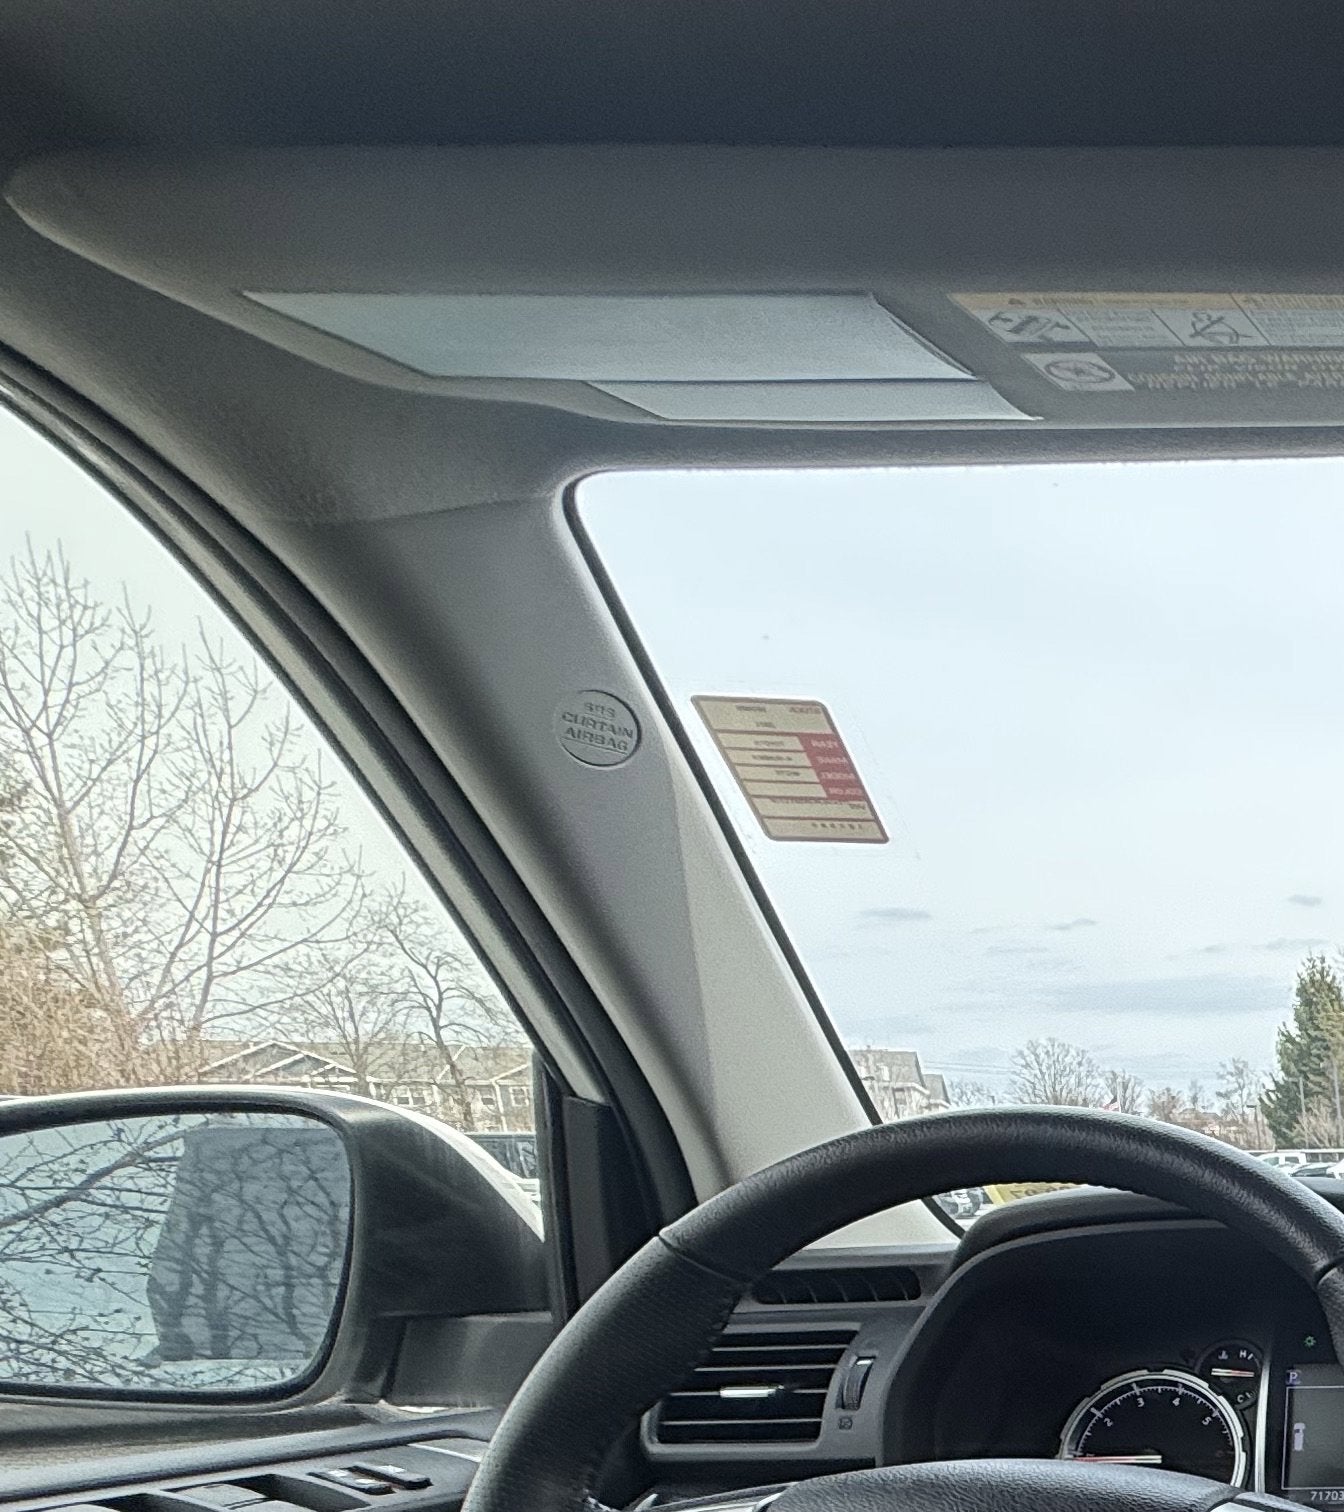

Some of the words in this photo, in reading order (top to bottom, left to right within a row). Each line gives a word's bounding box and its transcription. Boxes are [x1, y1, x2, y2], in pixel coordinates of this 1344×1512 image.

[561, 711, 634, 739] CURTAIN
[564, 726, 628, 751] AIRBAG
[1288, 1371, 1298, 1384] P
[1136, 1397, 1145, 1407] 3
[1171, 1398, 1181, 1407] 4
[1201, 1415, 1212, 1426] 5
